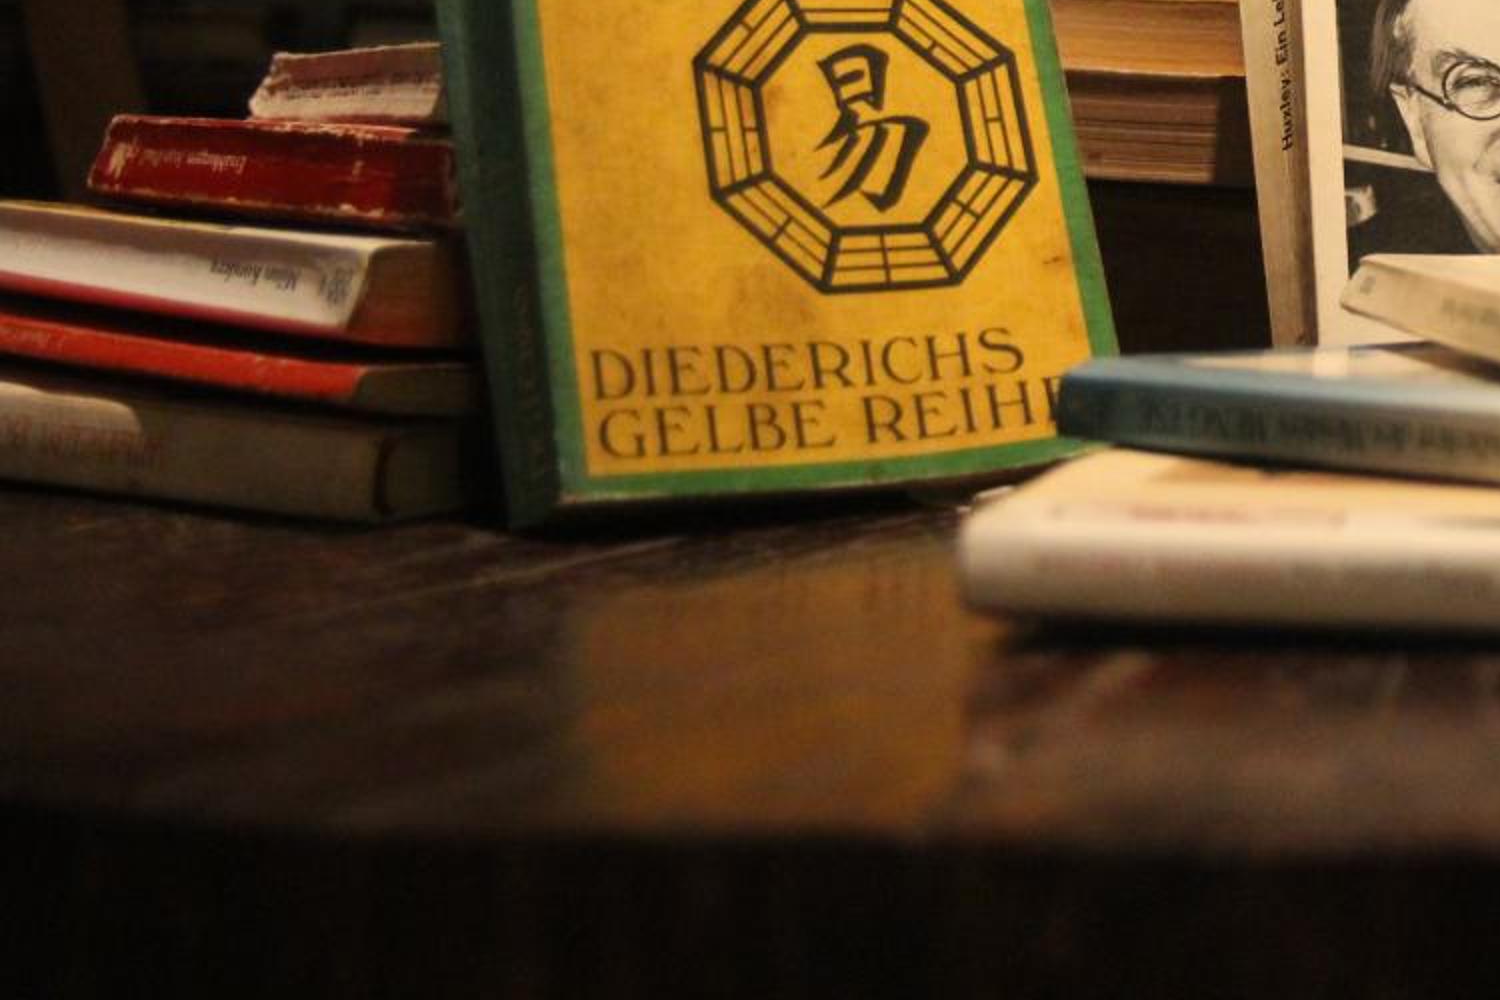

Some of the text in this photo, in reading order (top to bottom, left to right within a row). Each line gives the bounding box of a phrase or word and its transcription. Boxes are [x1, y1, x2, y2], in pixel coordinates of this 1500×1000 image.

[1275, 30, 1289, 66] Ein
[590, 327, 1025, 401] DIEDERICHS
[598, 398, 836, 459] GELBE
